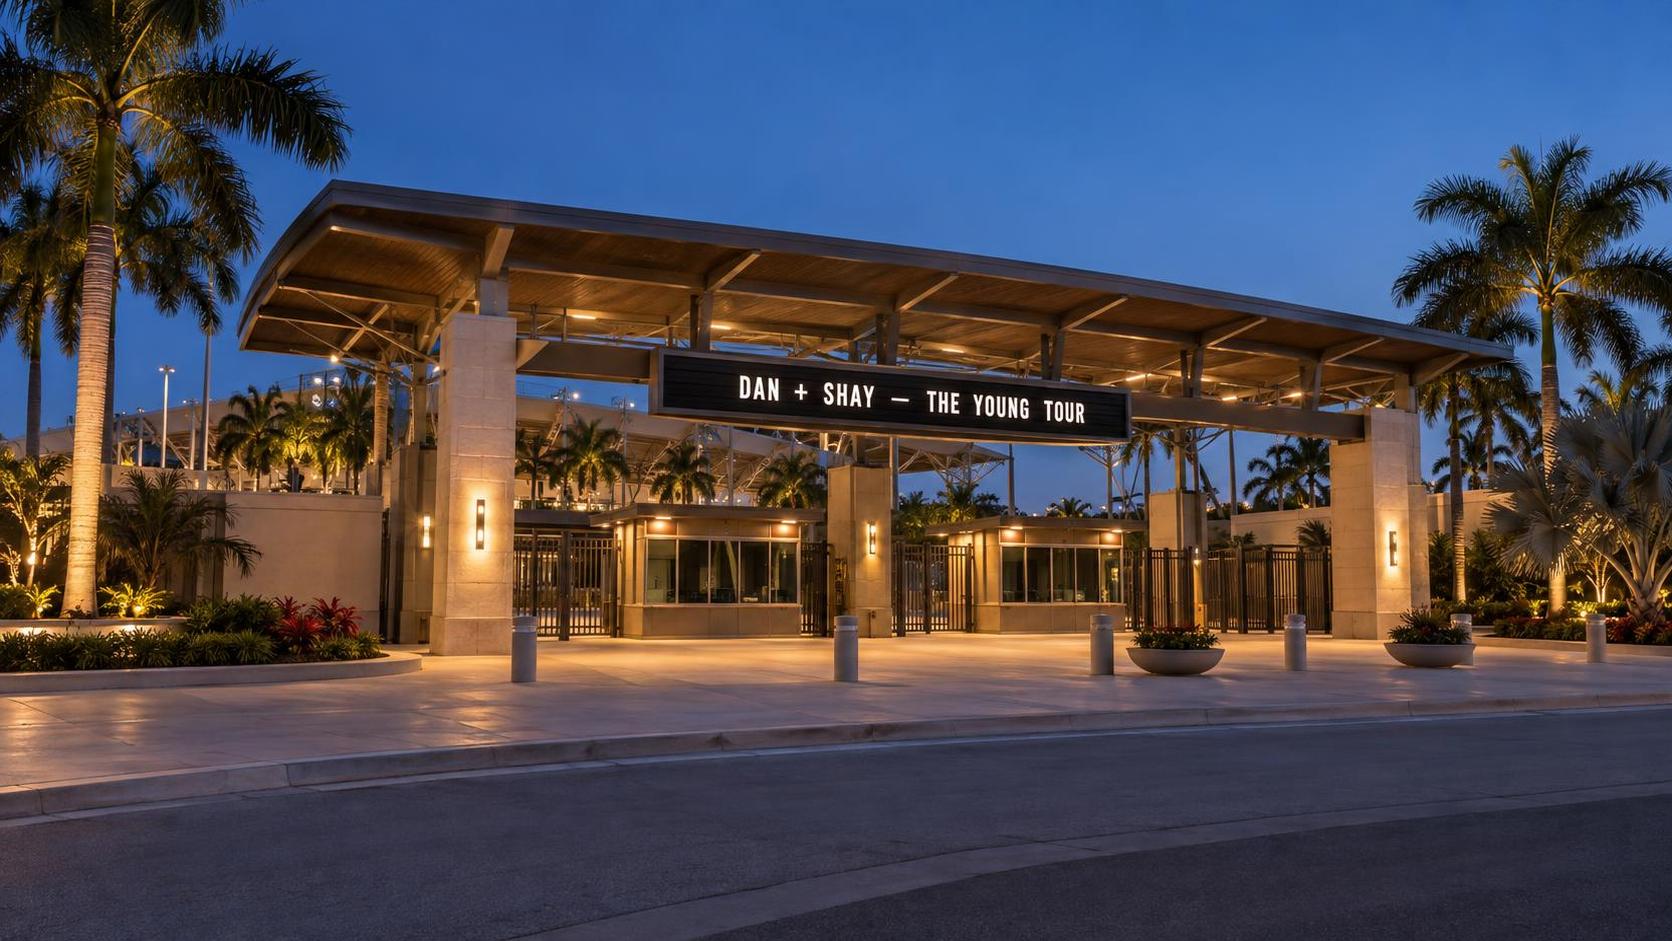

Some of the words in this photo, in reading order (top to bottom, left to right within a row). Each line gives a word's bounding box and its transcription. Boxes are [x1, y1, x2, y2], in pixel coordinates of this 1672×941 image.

[739, 374, 780, 401] DAN
[794, 383, 808, 401] +
[823, 381, 875, 408] SHAY
[926, 390, 960, 415] THE
[972, 393, 1030, 420] YOUNG
[1043, 399, 1085, 424] TOUR
